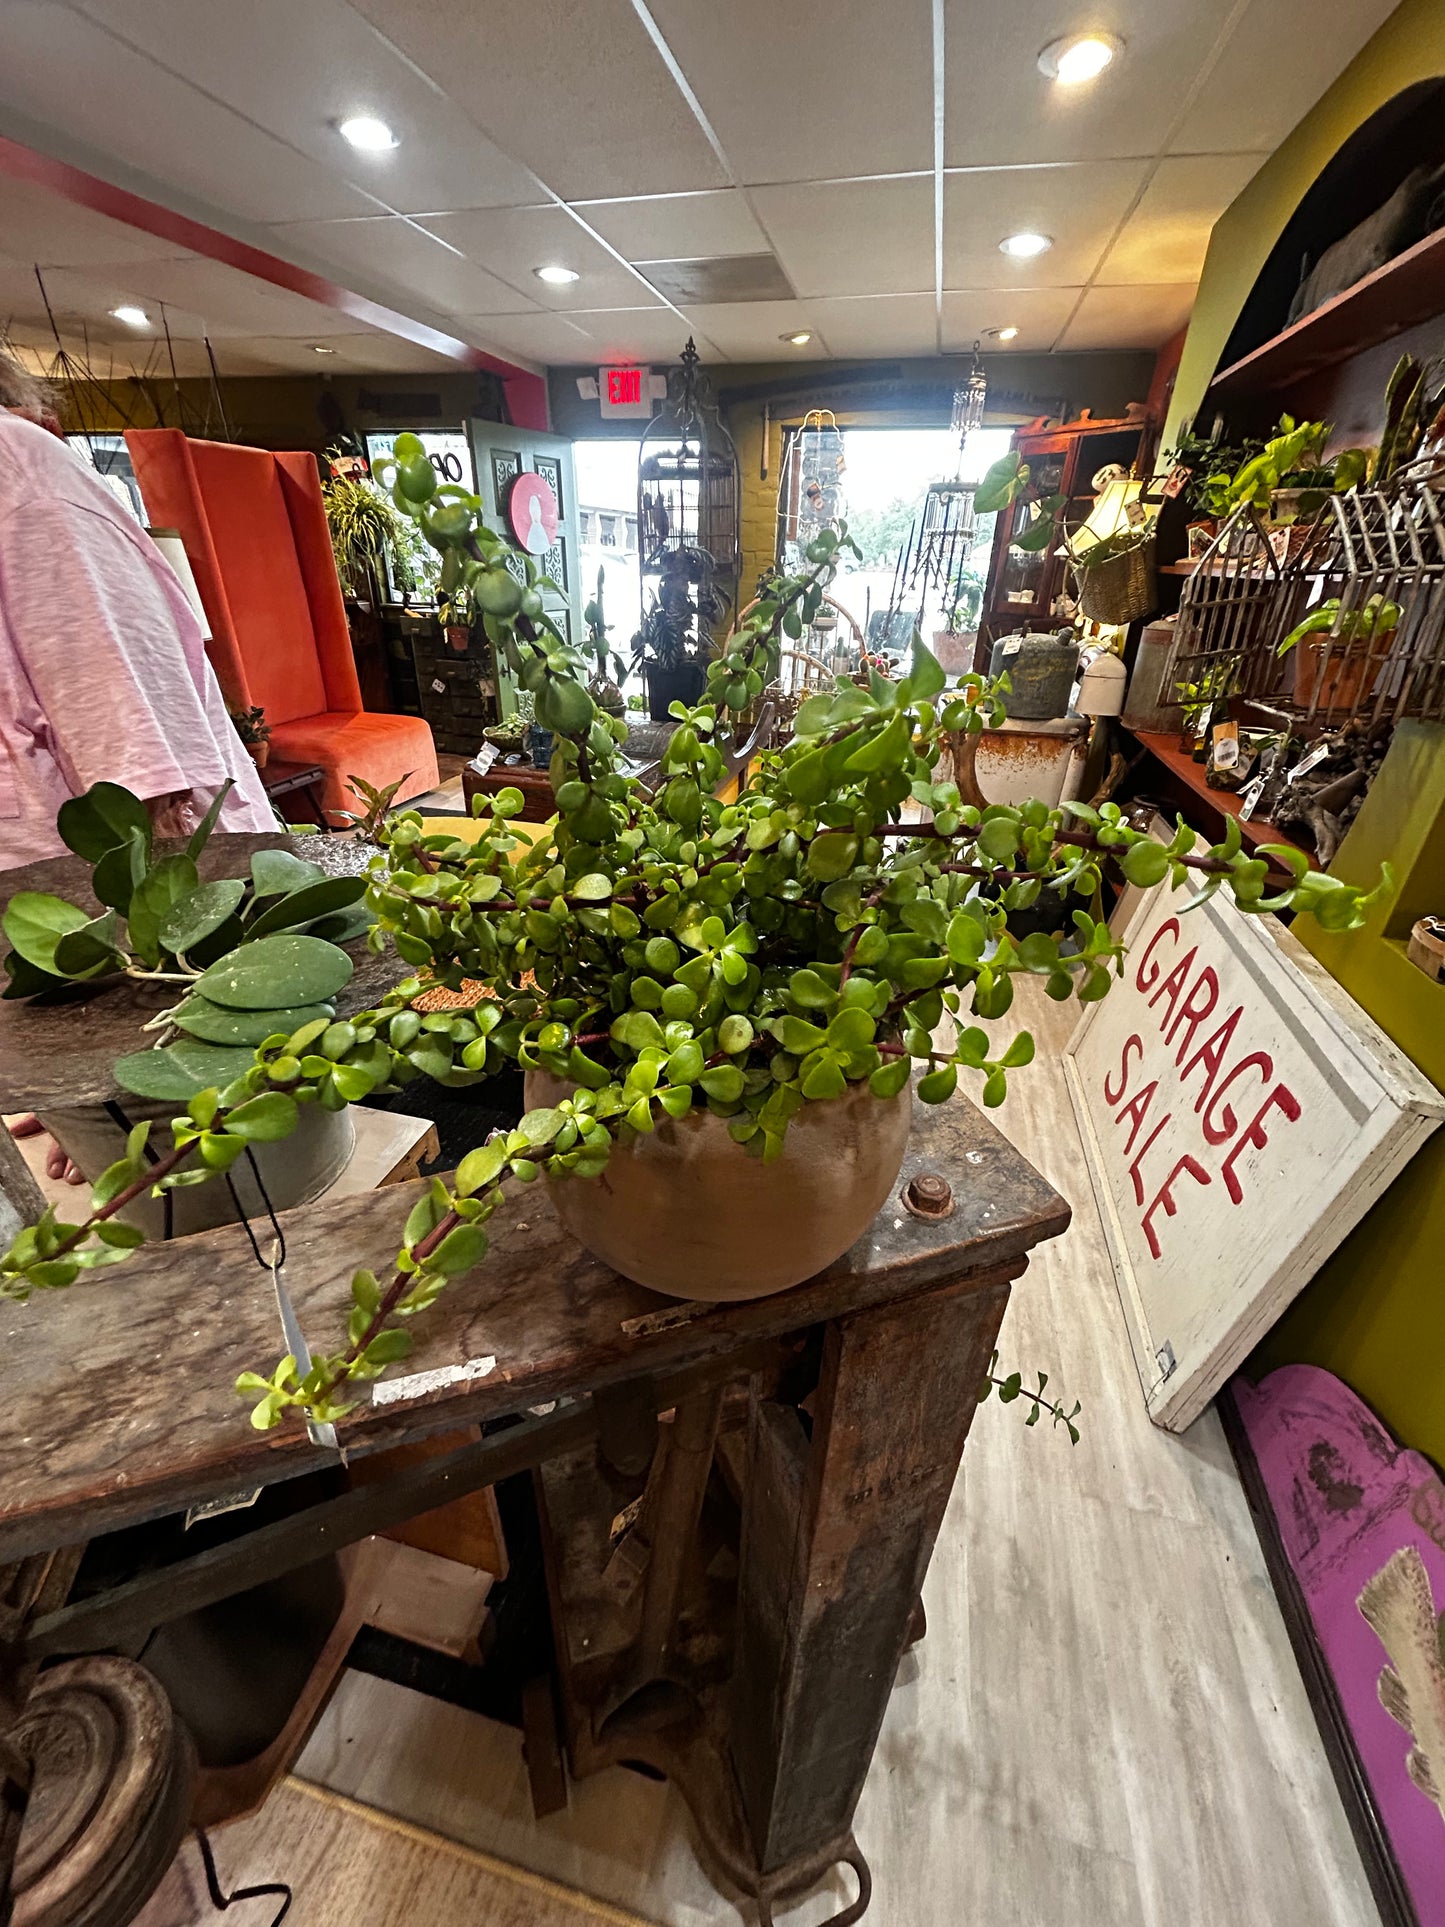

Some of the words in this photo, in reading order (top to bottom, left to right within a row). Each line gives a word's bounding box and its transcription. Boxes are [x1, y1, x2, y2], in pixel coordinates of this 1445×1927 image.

[608, 370, 642, 404] EXIT
[1105, 1034, 1212, 1260] SALE
[1136, 918, 1301, 1205] GARAGE
